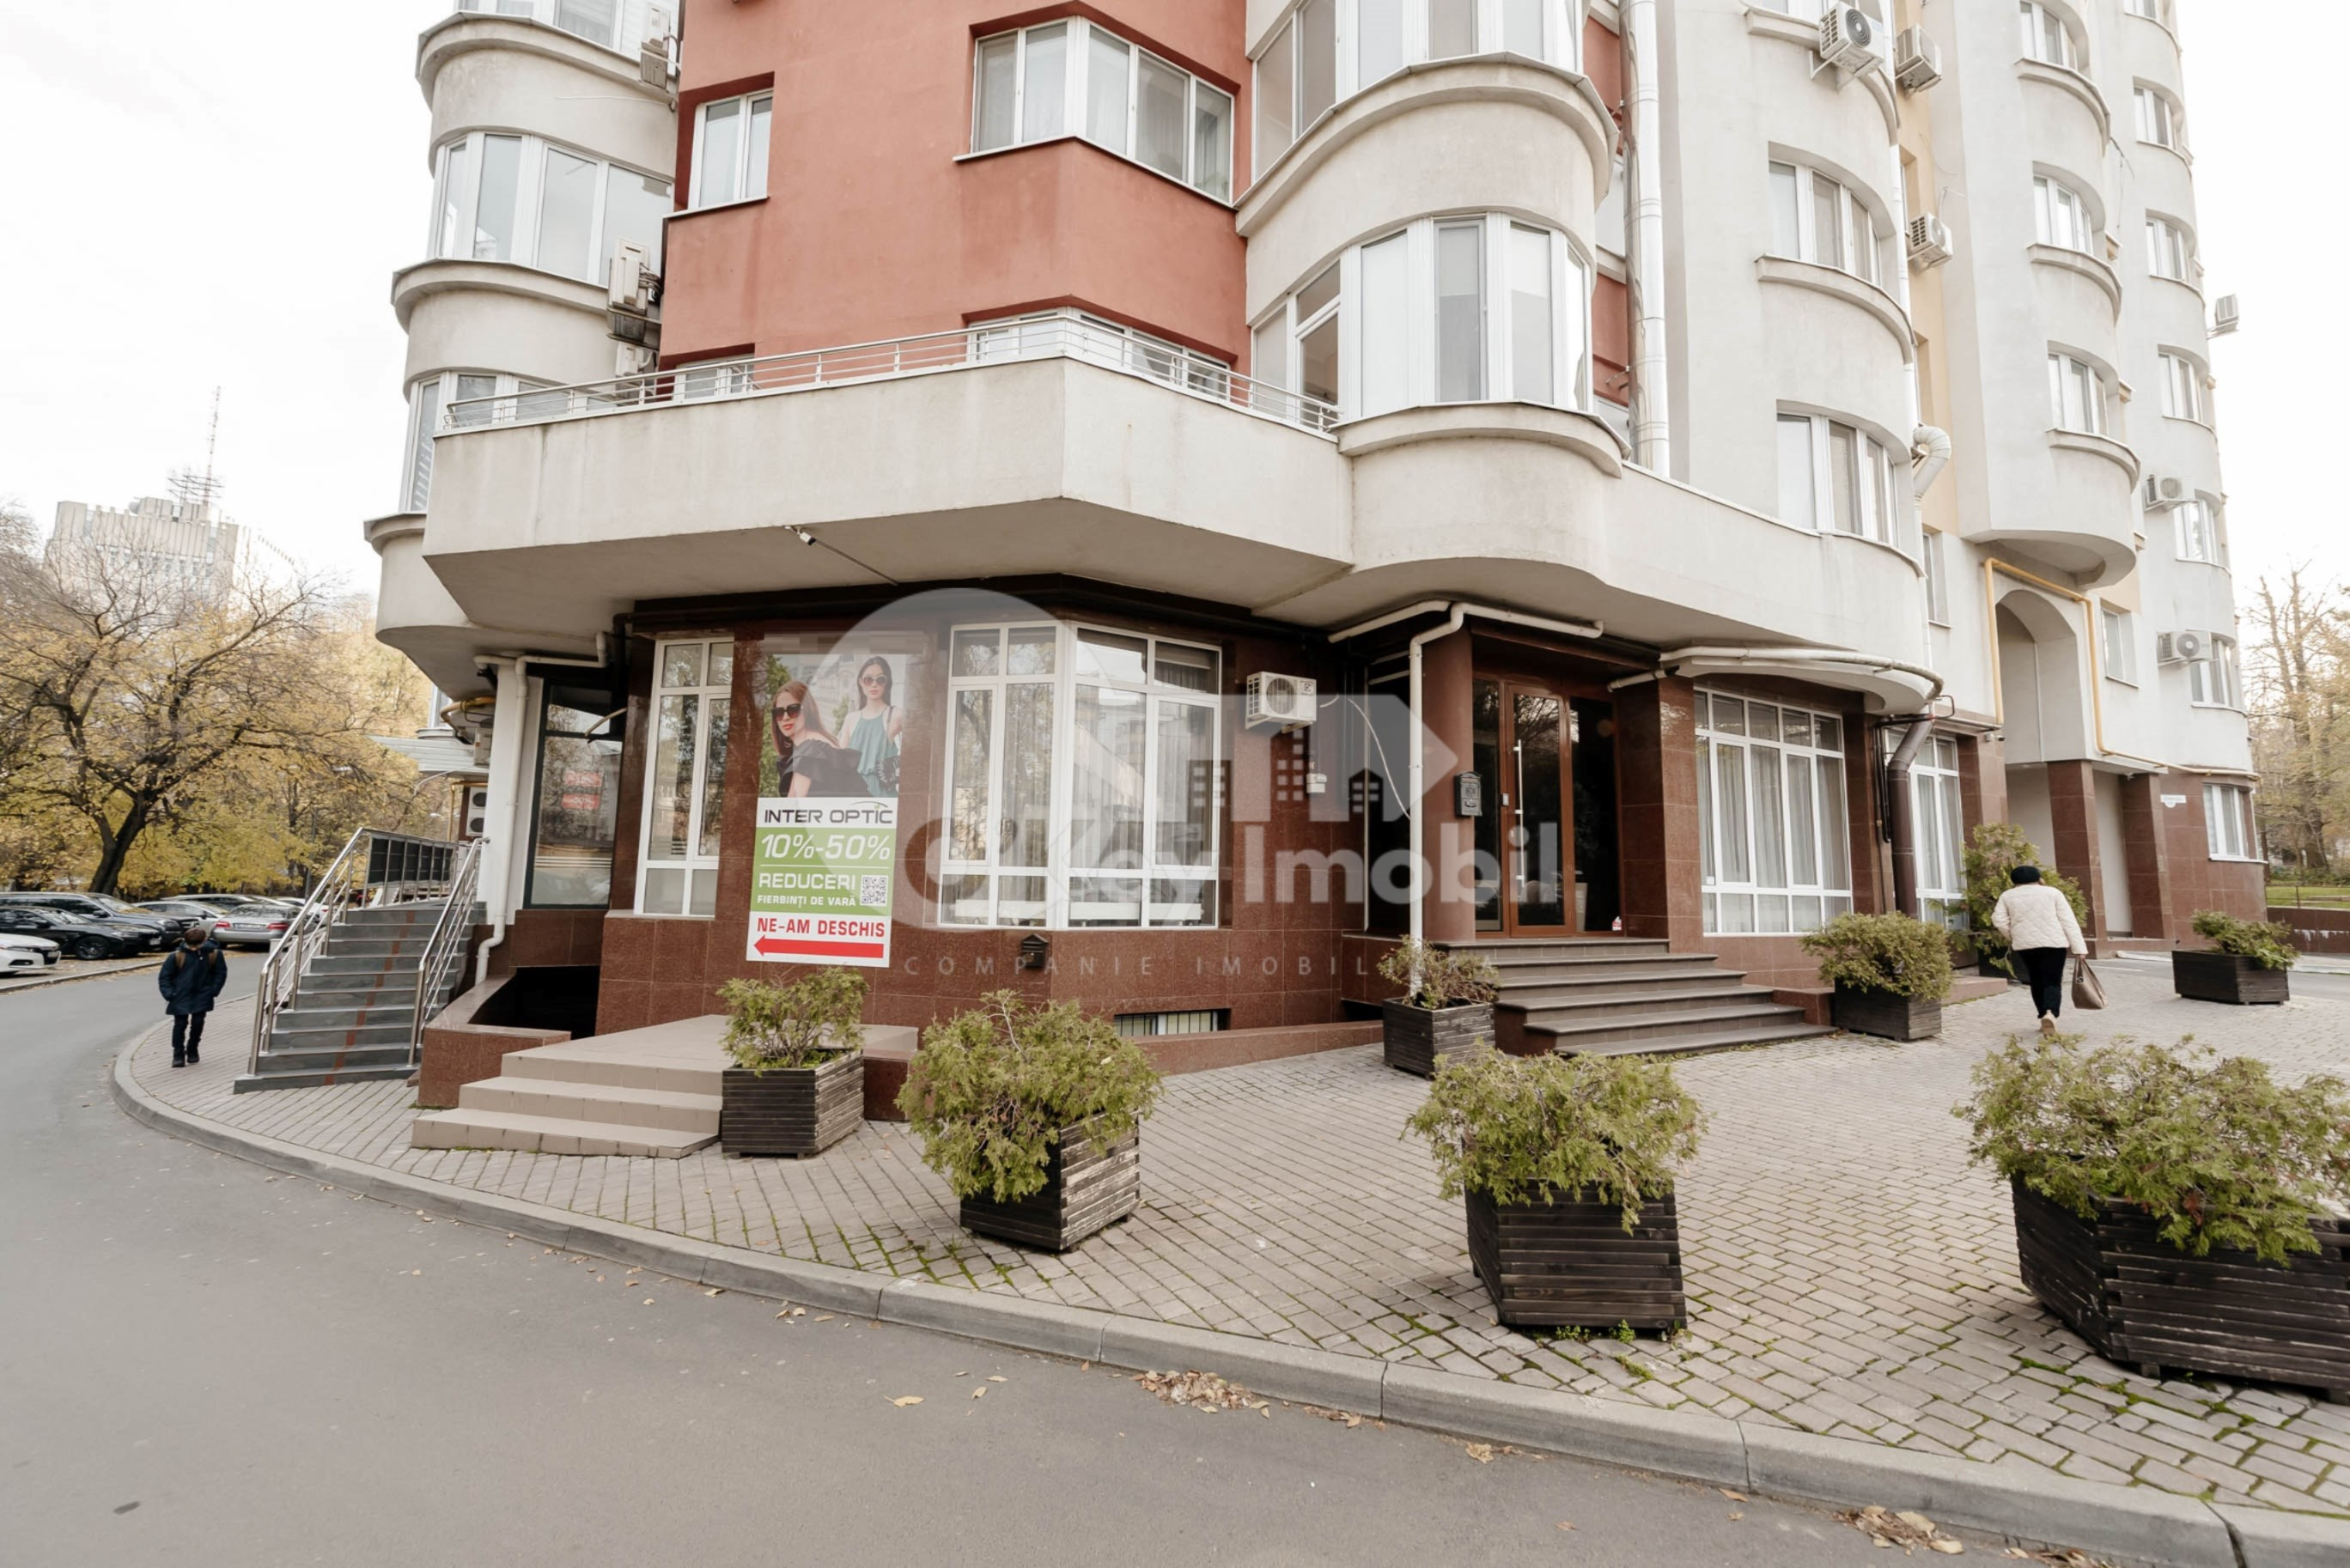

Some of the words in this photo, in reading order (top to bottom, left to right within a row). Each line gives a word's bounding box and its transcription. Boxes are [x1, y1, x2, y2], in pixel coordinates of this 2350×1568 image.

[764, 809, 822, 823] INTER
[830, 806, 893, 824] OPTIC
[762, 834, 891, 860] 10%-50%
[758, 872, 855, 890] REDUCERI
[810, 896, 824, 906] DE
[827, 896, 856, 907] VARĂ
[757, 917, 810, 933] NE-AM
[818, 920, 885, 937] DESCHIS
